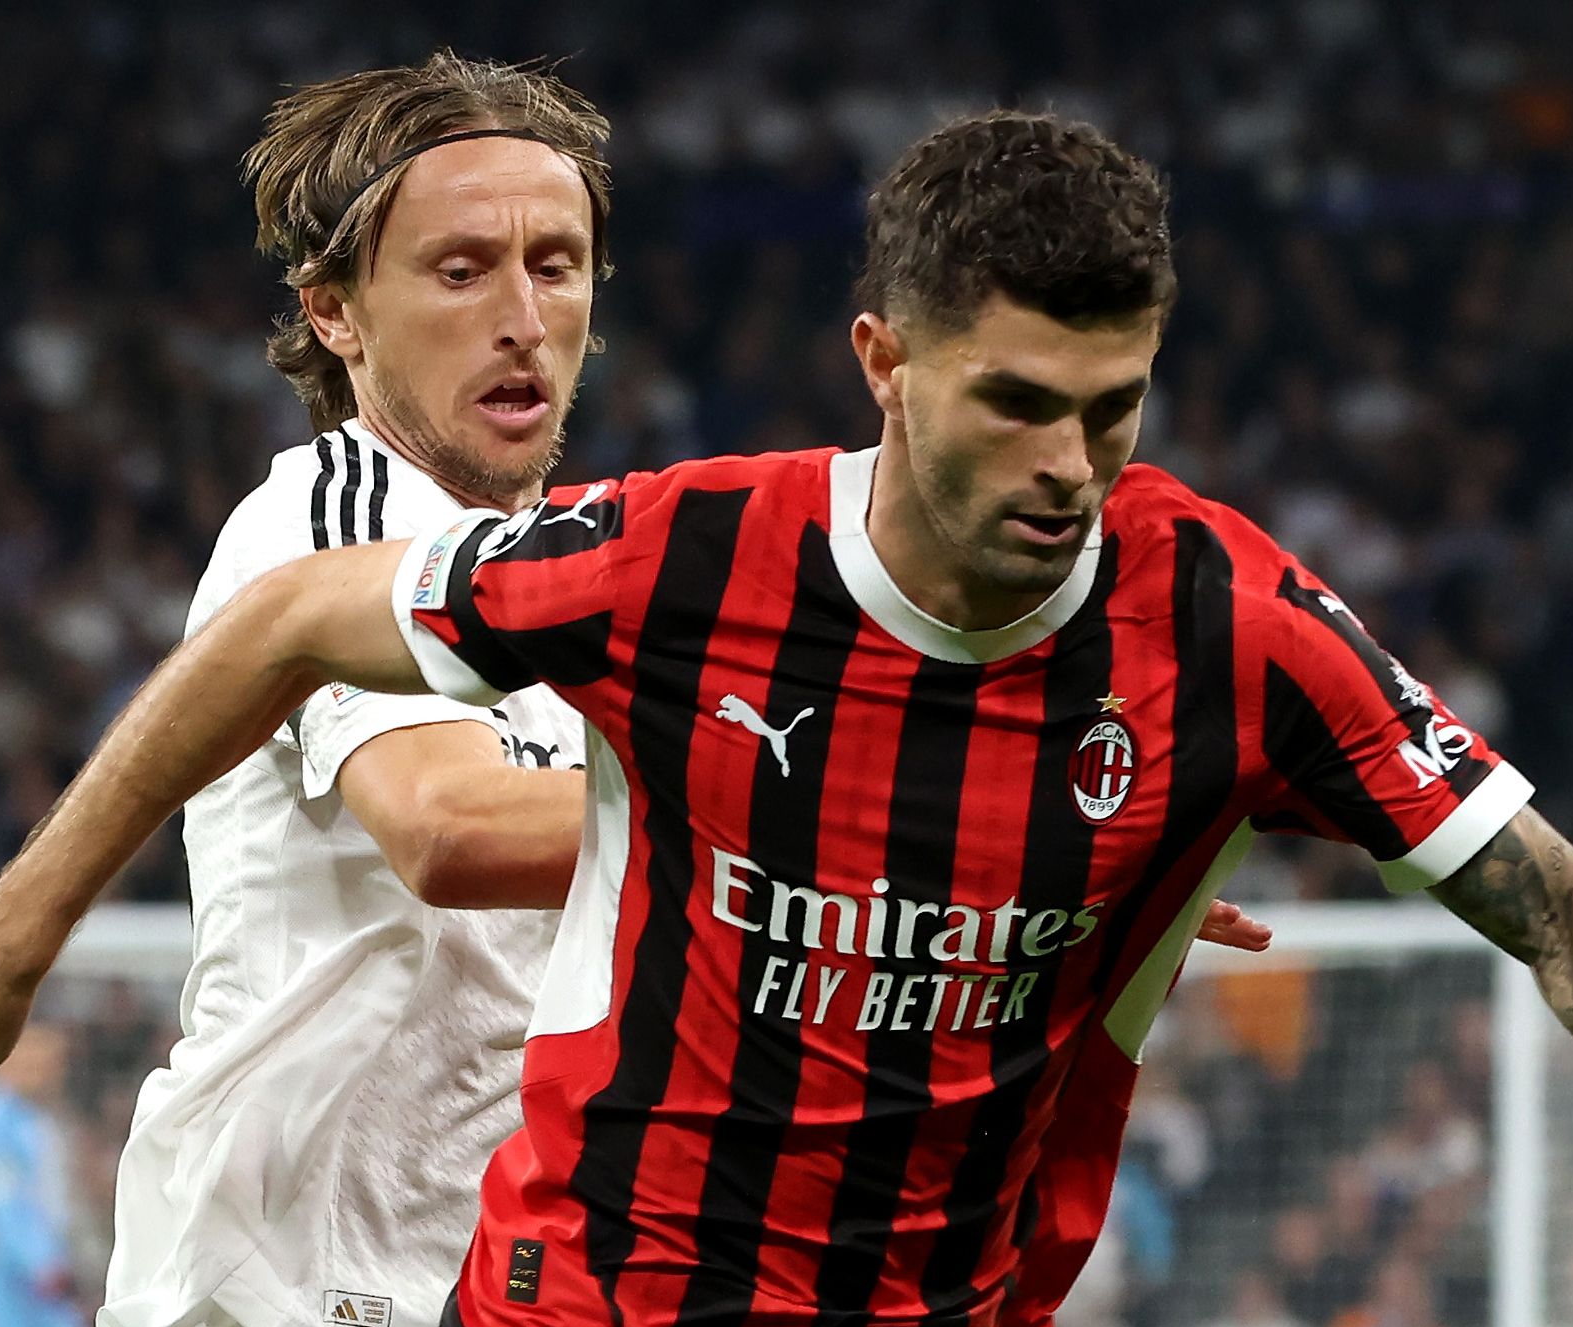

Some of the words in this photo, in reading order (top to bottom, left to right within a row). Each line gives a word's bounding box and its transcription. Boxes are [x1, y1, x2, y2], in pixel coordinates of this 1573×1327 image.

[1088, 723, 1127, 743] ACM
[1396, 704, 1474, 789] MS
[1082, 798, 1115, 812] 1899
[710, 845, 1106, 963] Emirates
[752, 955, 847, 1025] FLY
[855, 971, 1039, 1032] BETTER
